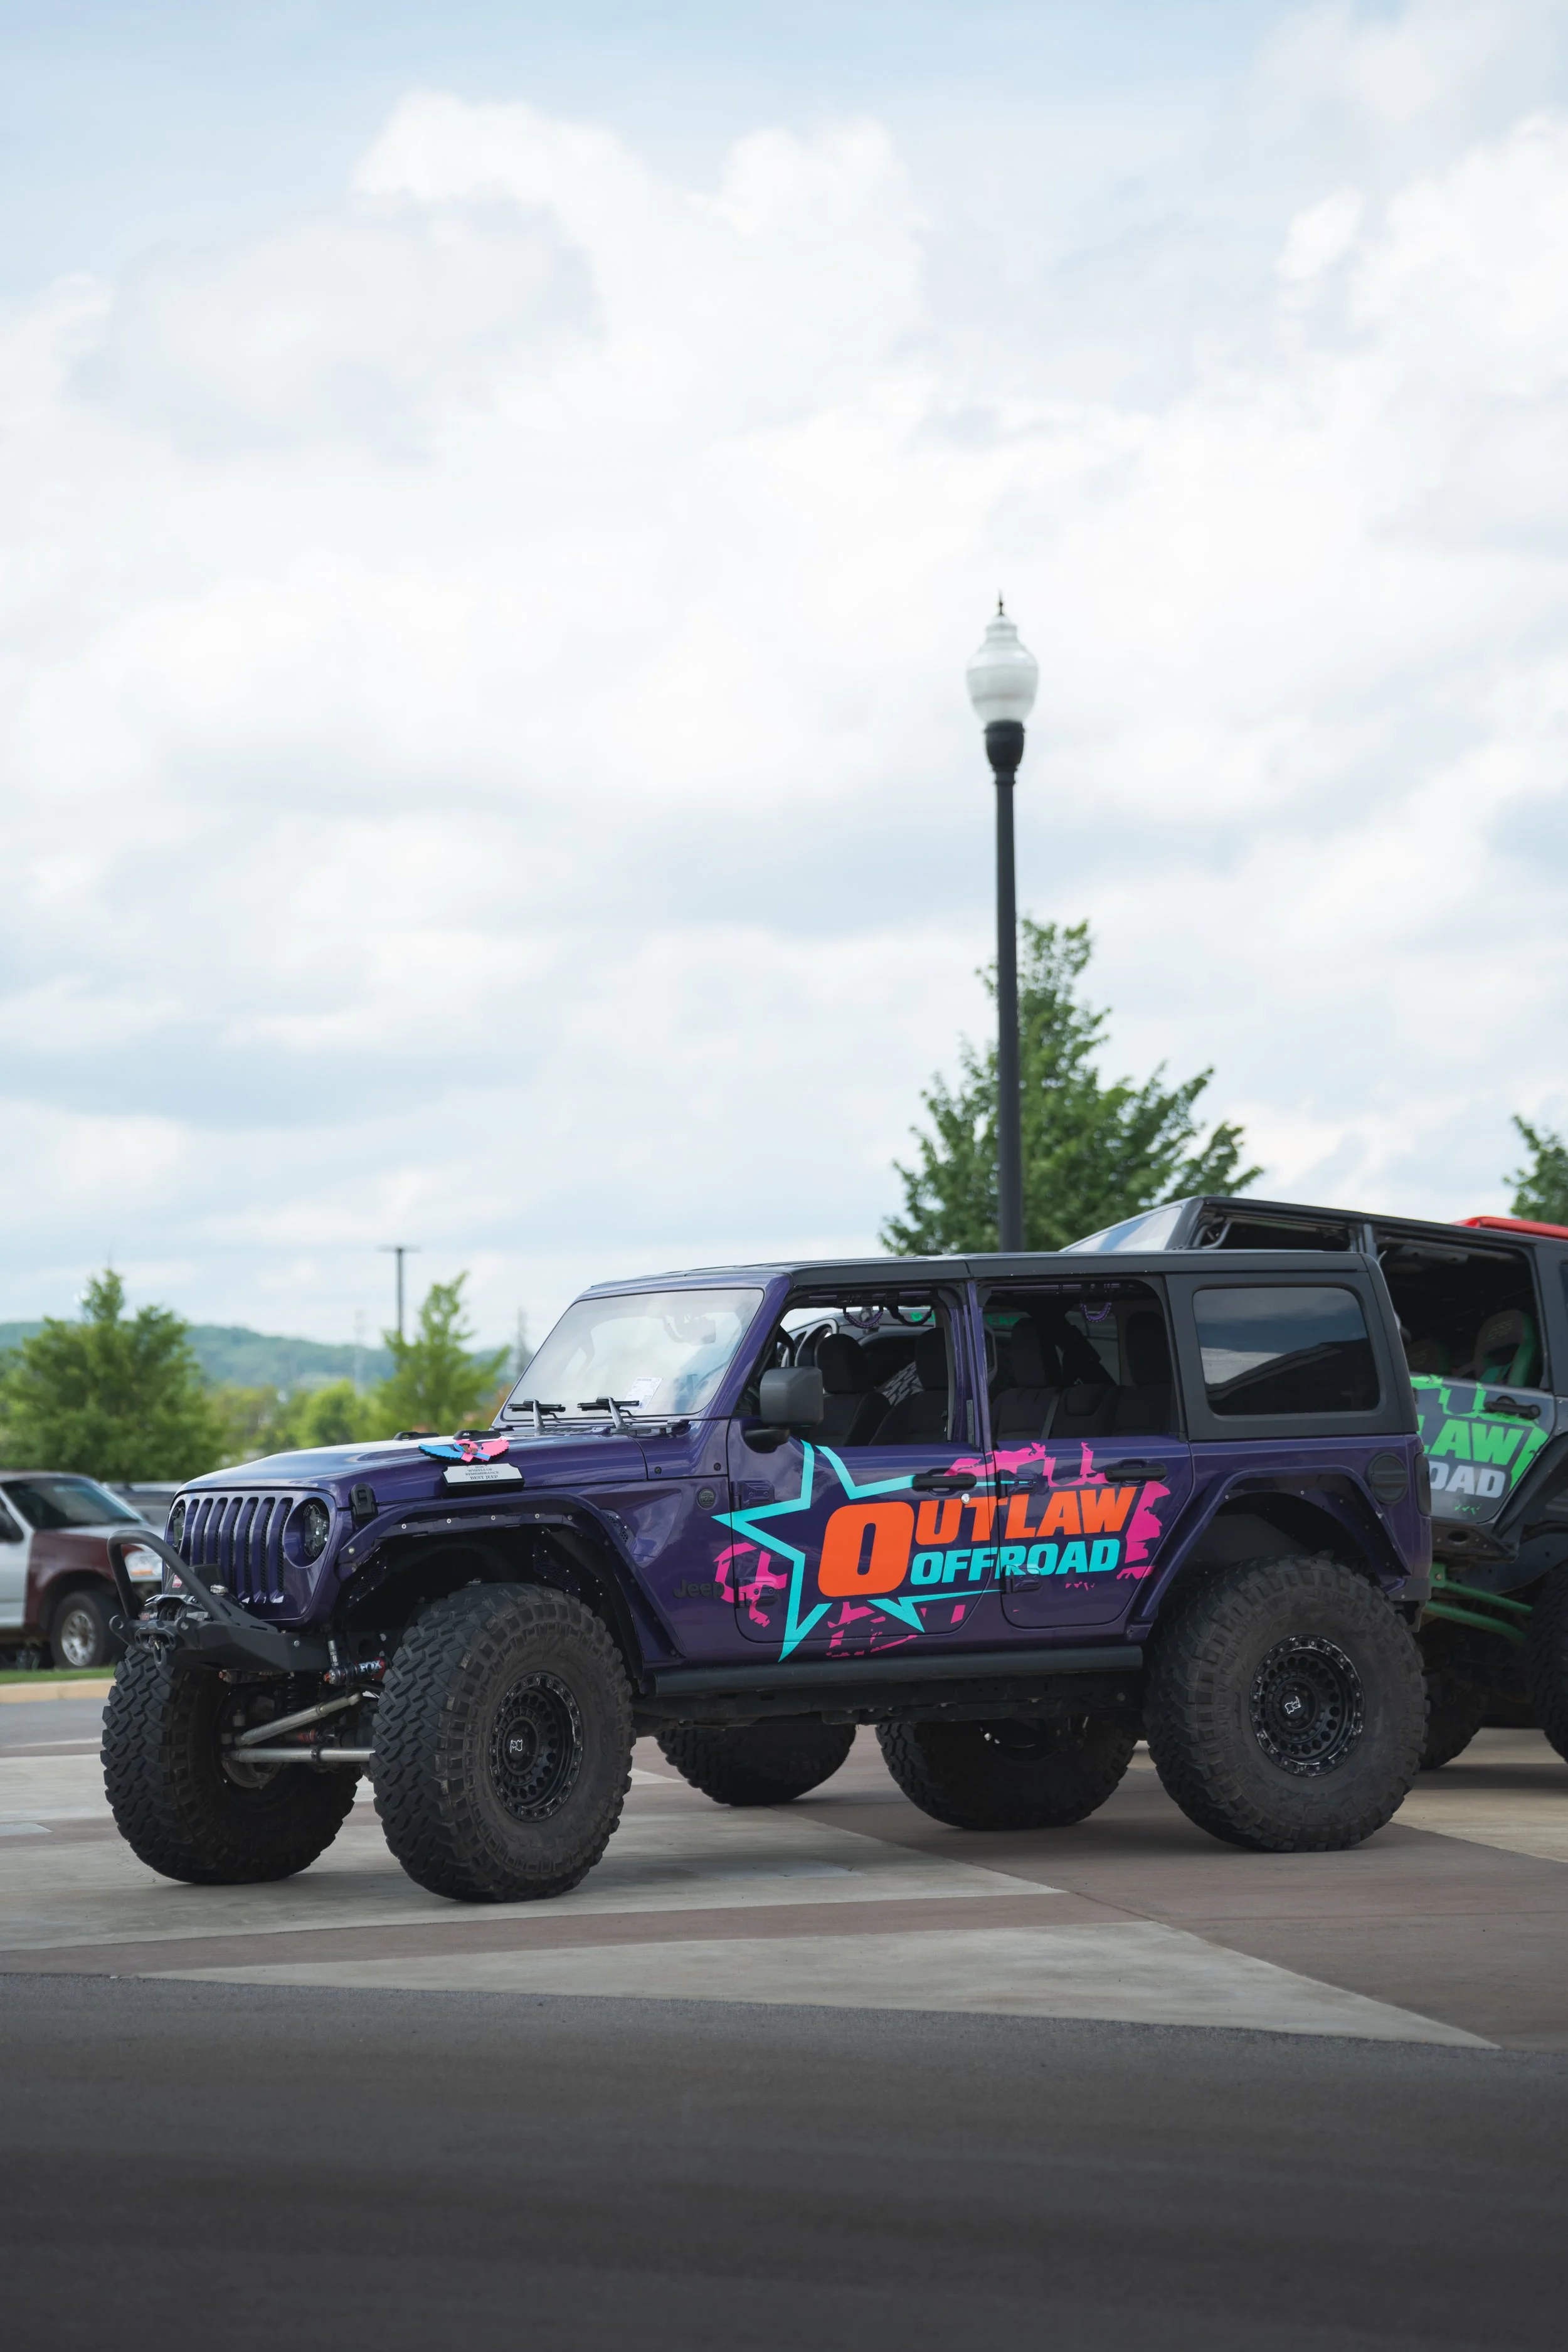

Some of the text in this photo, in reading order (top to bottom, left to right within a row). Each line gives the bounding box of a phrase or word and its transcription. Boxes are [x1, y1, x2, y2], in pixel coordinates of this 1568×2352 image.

[818, 1486, 1137, 1597] OUTLAW
[910, 1538, 1120, 1586] OFFROAD
[672, 1577, 725, 1599] Jeep
[358, 1660, 382, 1673] FOX
